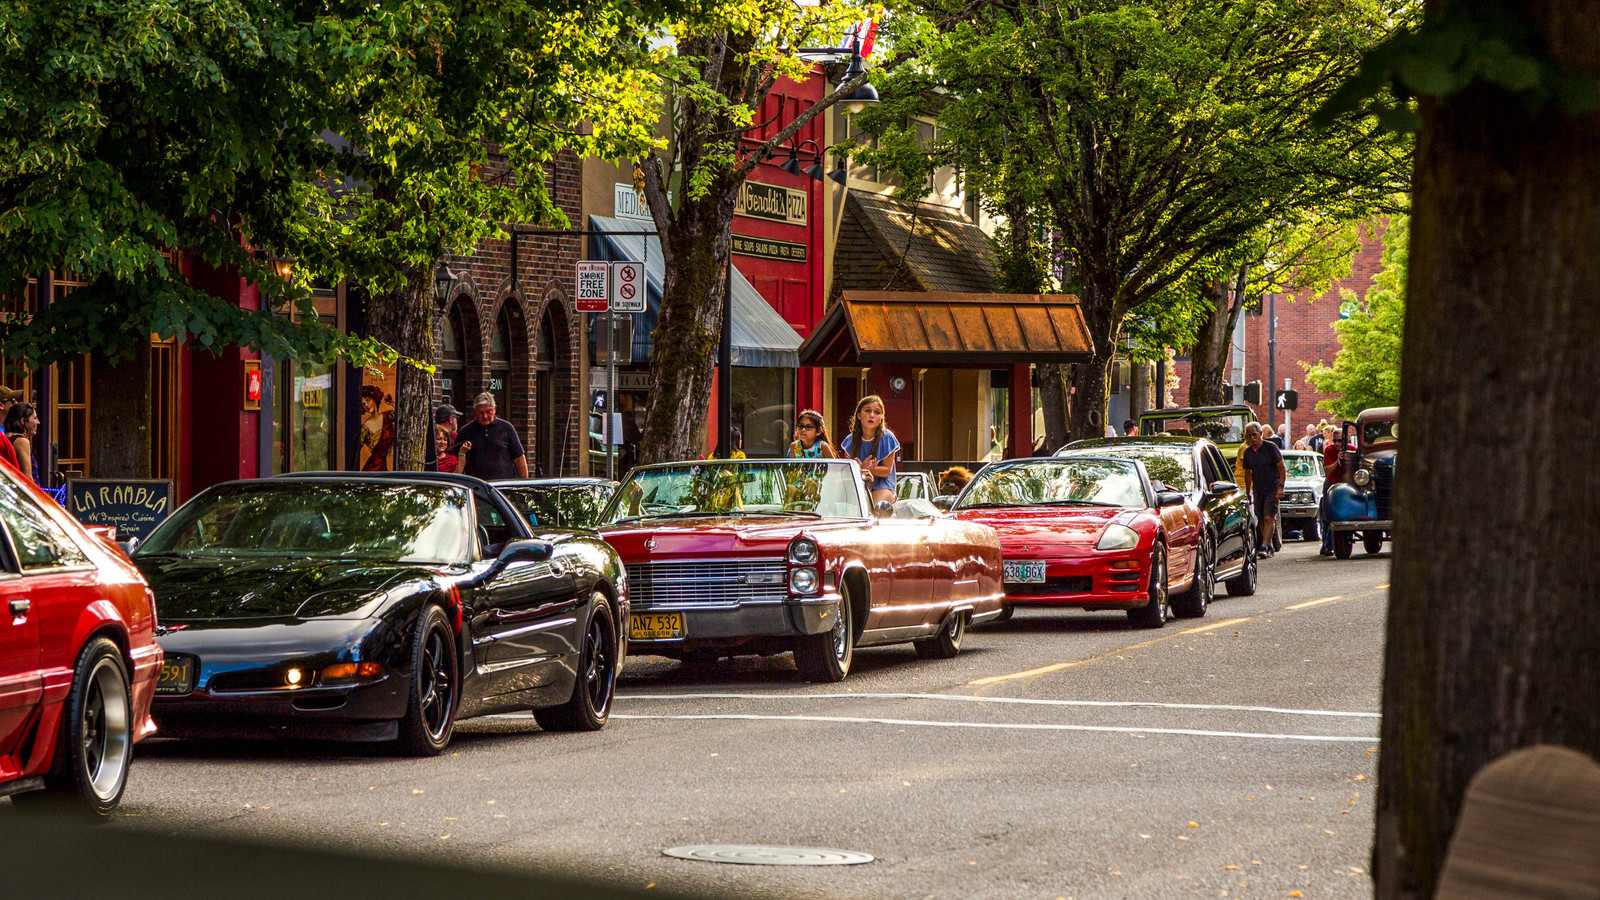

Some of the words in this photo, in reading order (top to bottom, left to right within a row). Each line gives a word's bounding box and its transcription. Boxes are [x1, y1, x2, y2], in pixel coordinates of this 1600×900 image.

[747, 185, 786, 215] Geraldi's
[788, 194, 806, 220] PIZZA
[580, 280, 604, 289] FREE
[580, 289, 605, 298] ZONE
[73, 490, 97, 512] LA
[100, 485, 167, 514] RAMBLA
[101, 511, 130, 526] Inspired
[131, 511, 155, 522] Cuisine
[120, 523, 140, 536] Spain
[1004, 566, 1020, 578] 638
[1025, 566, 1043, 578] BGX
[632, 616, 653, 631] ANZ
[657, 615, 679, 630] 532
[157, 665, 187, 682] 591
